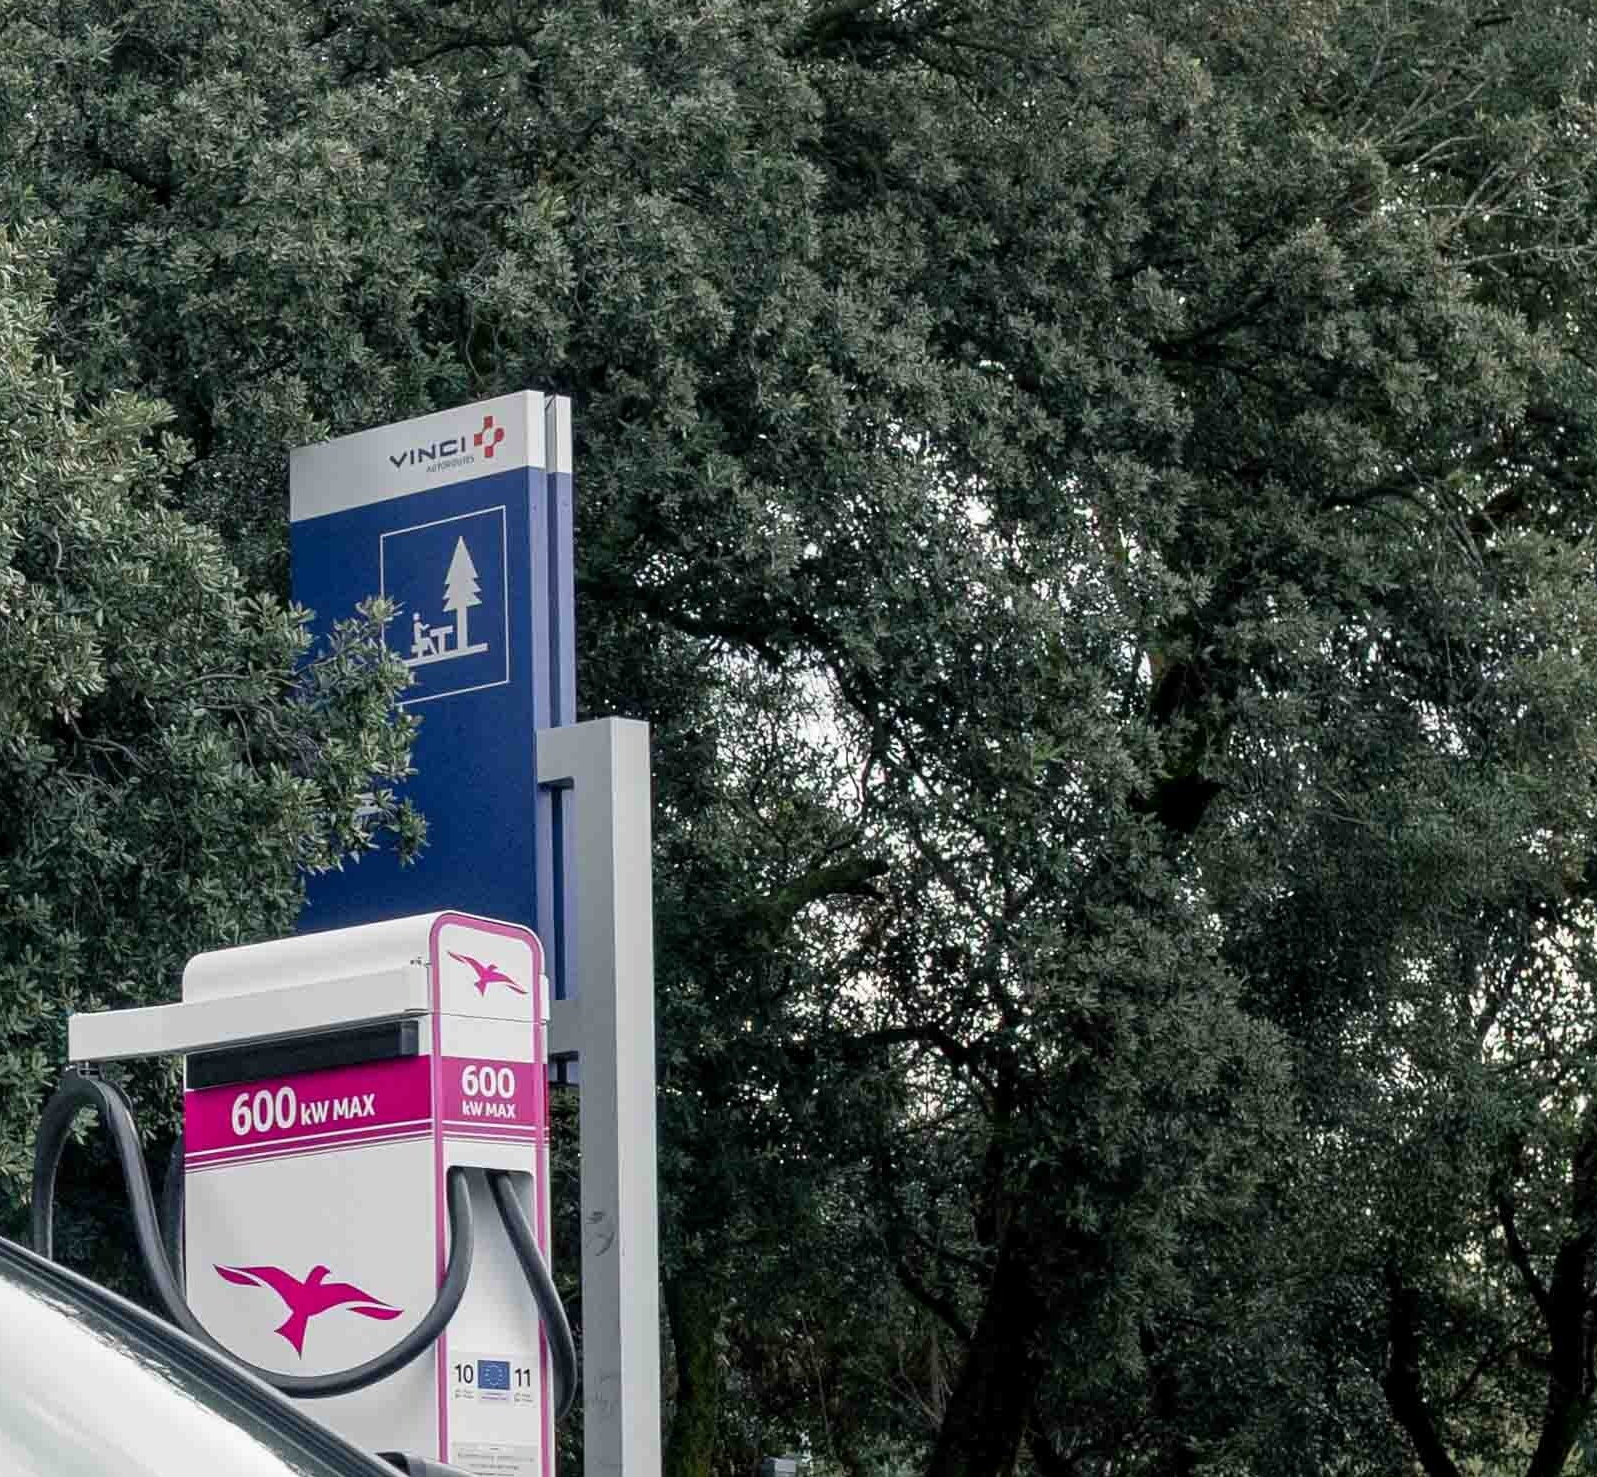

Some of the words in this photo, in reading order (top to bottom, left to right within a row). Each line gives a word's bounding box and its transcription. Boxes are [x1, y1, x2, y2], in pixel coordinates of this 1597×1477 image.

[389, 436, 466, 469] VINCI
[461, 1064, 515, 1098] 600
[231, 1086, 297, 1136] 600
[300, 1100, 331, 1126] kW
[333, 1093, 376, 1119] MAX
[462, 1099, 483, 1116] kW
[485, 1102, 516, 1119] MAX
[454, 1363, 474, 1385] 10
[515, 1368, 531, 1388] 11
